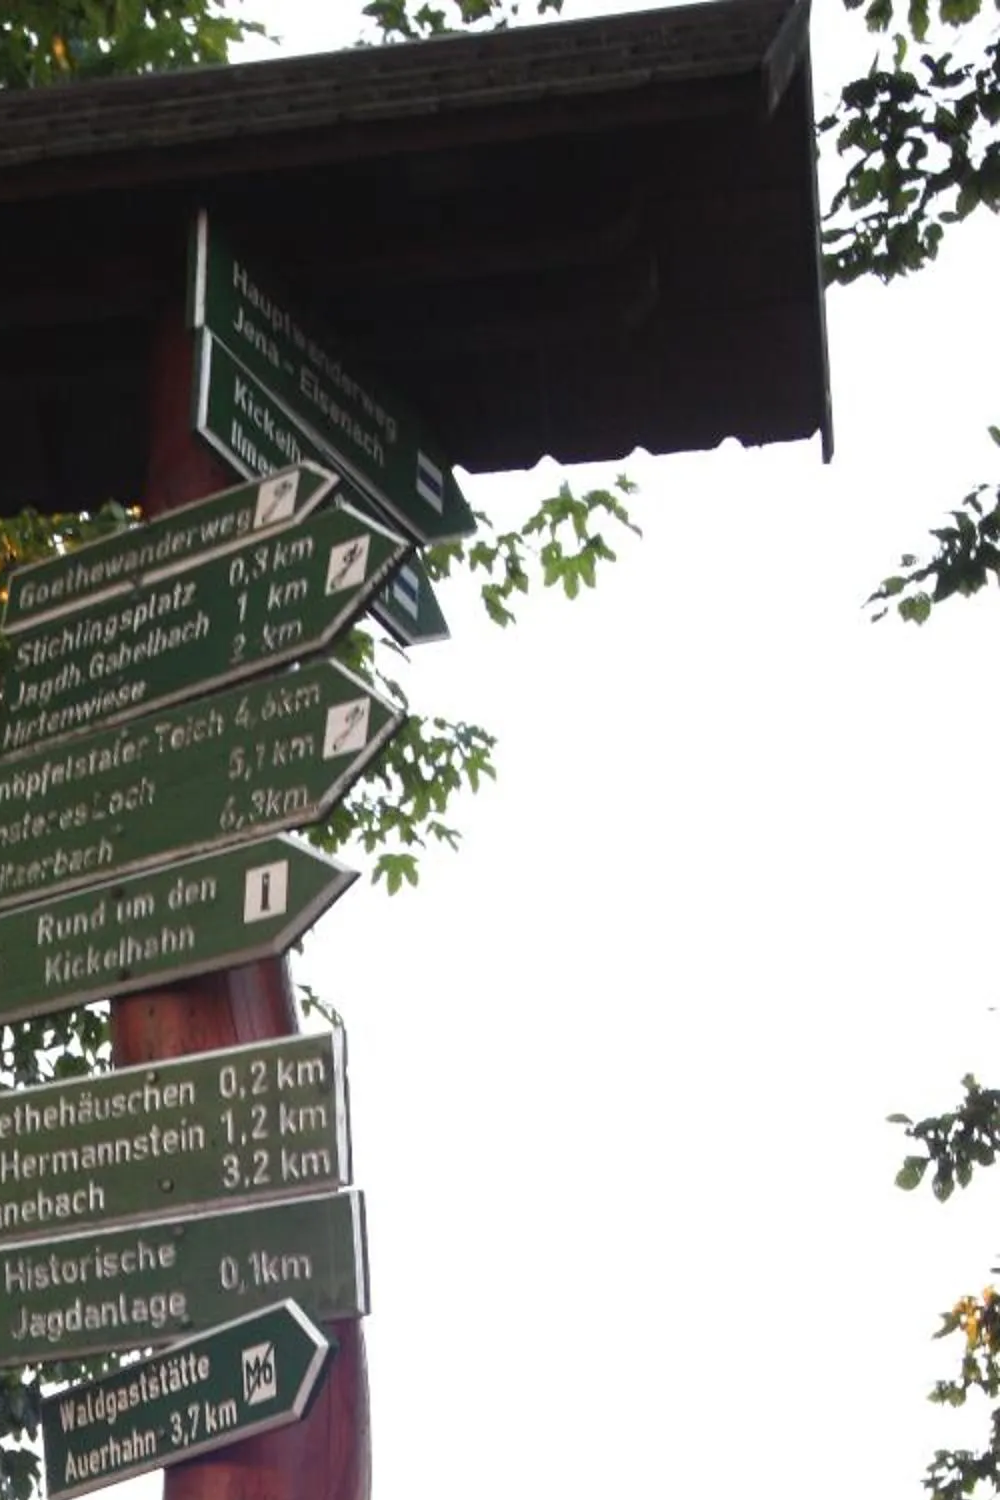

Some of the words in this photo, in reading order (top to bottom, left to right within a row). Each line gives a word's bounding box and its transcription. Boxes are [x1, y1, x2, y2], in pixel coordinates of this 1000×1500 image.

[233, 307, 280, 368] Jena
[299, 368, 386, 467] Eisenach
[19, 508, 253, 611] Goethewanderweg
[15, 579, 197, 672] Stichlingsplatz
[235, 594, 248, 626] 1
[267, 578, 308, 611] km
[3, 680, 147, 751] Hirtenwiese
[261, 619, 301, 654] km
[155, 708, 223, 755] Teich
[93, 777, 156, 820] Loch
[36, 904, 106, 946] Rund
[116, 892, 155, 922] um
[167, 875, 218, 911] den
[44, 923, 196, 987] Kickelhahn
[4, 1241, 177, 1294] Historische
[11, 1290, 188, 1343] Jagdanlage
[59, 1352, 211, 1434] Waldgaststätte
[64, 1429, 157, 1484] Auerhahn
